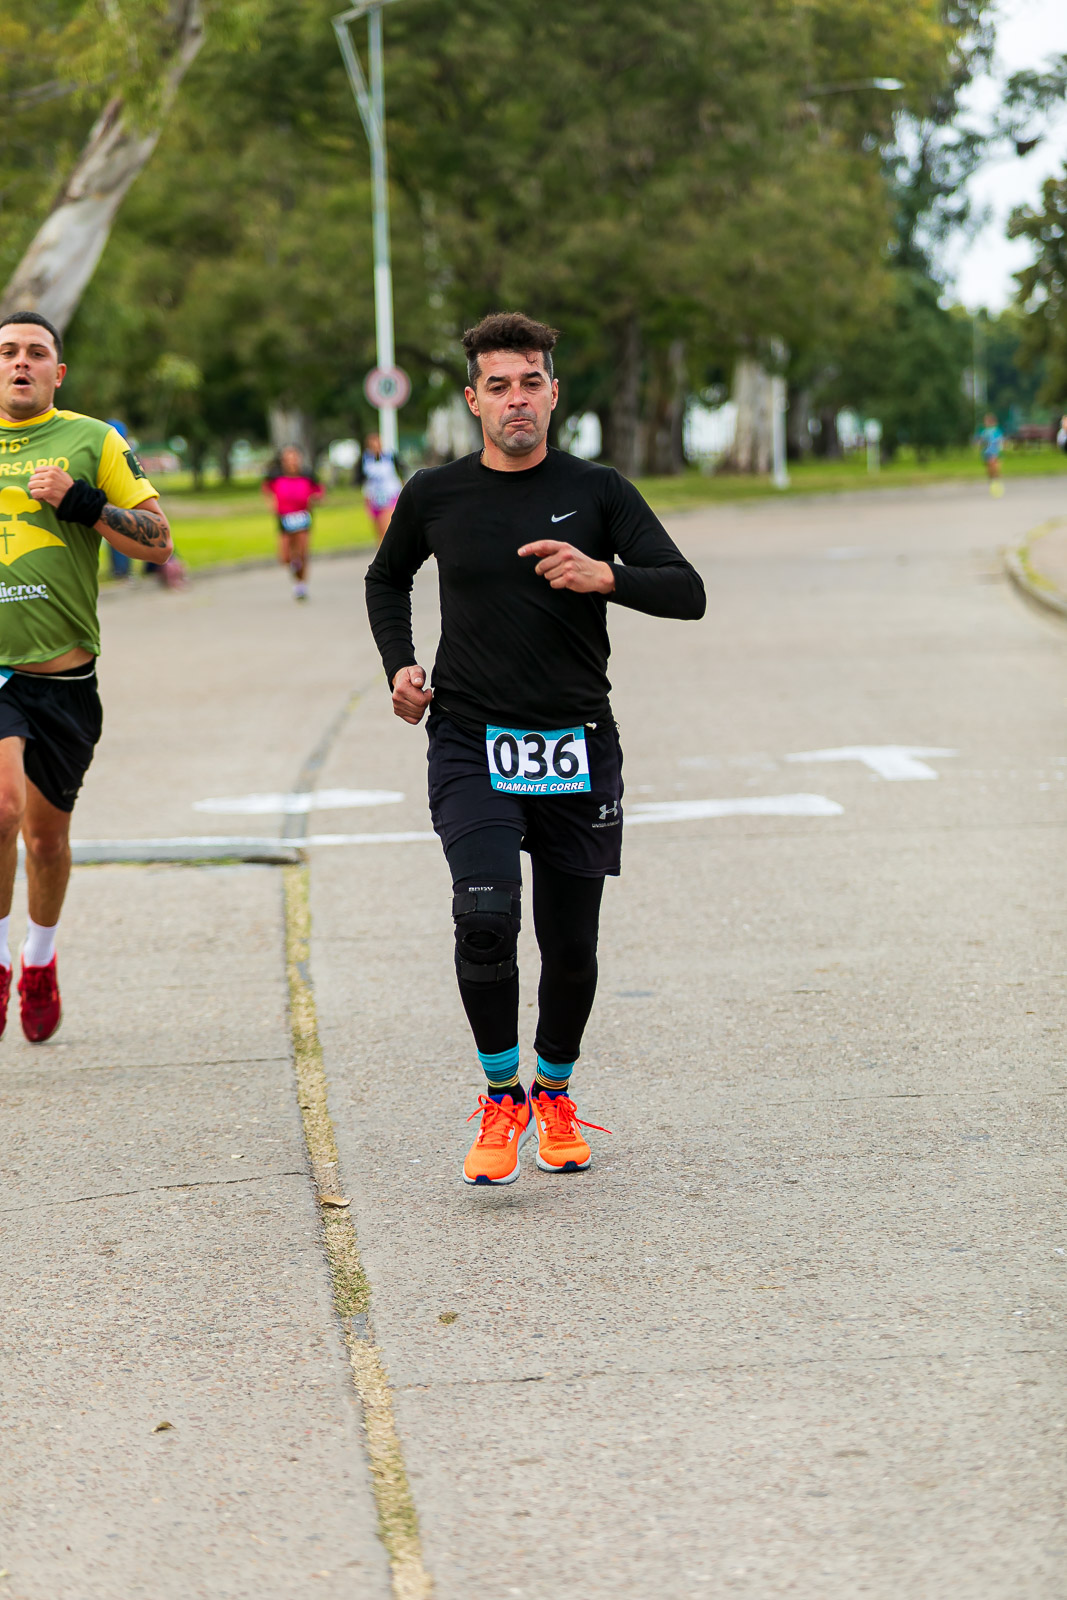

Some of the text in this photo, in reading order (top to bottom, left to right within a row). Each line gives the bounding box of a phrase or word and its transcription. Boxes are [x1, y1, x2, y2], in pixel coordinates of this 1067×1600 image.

[492, 732, 579, 781] 036
[496, 781, 585, 792] DIAMANTE CORRE
